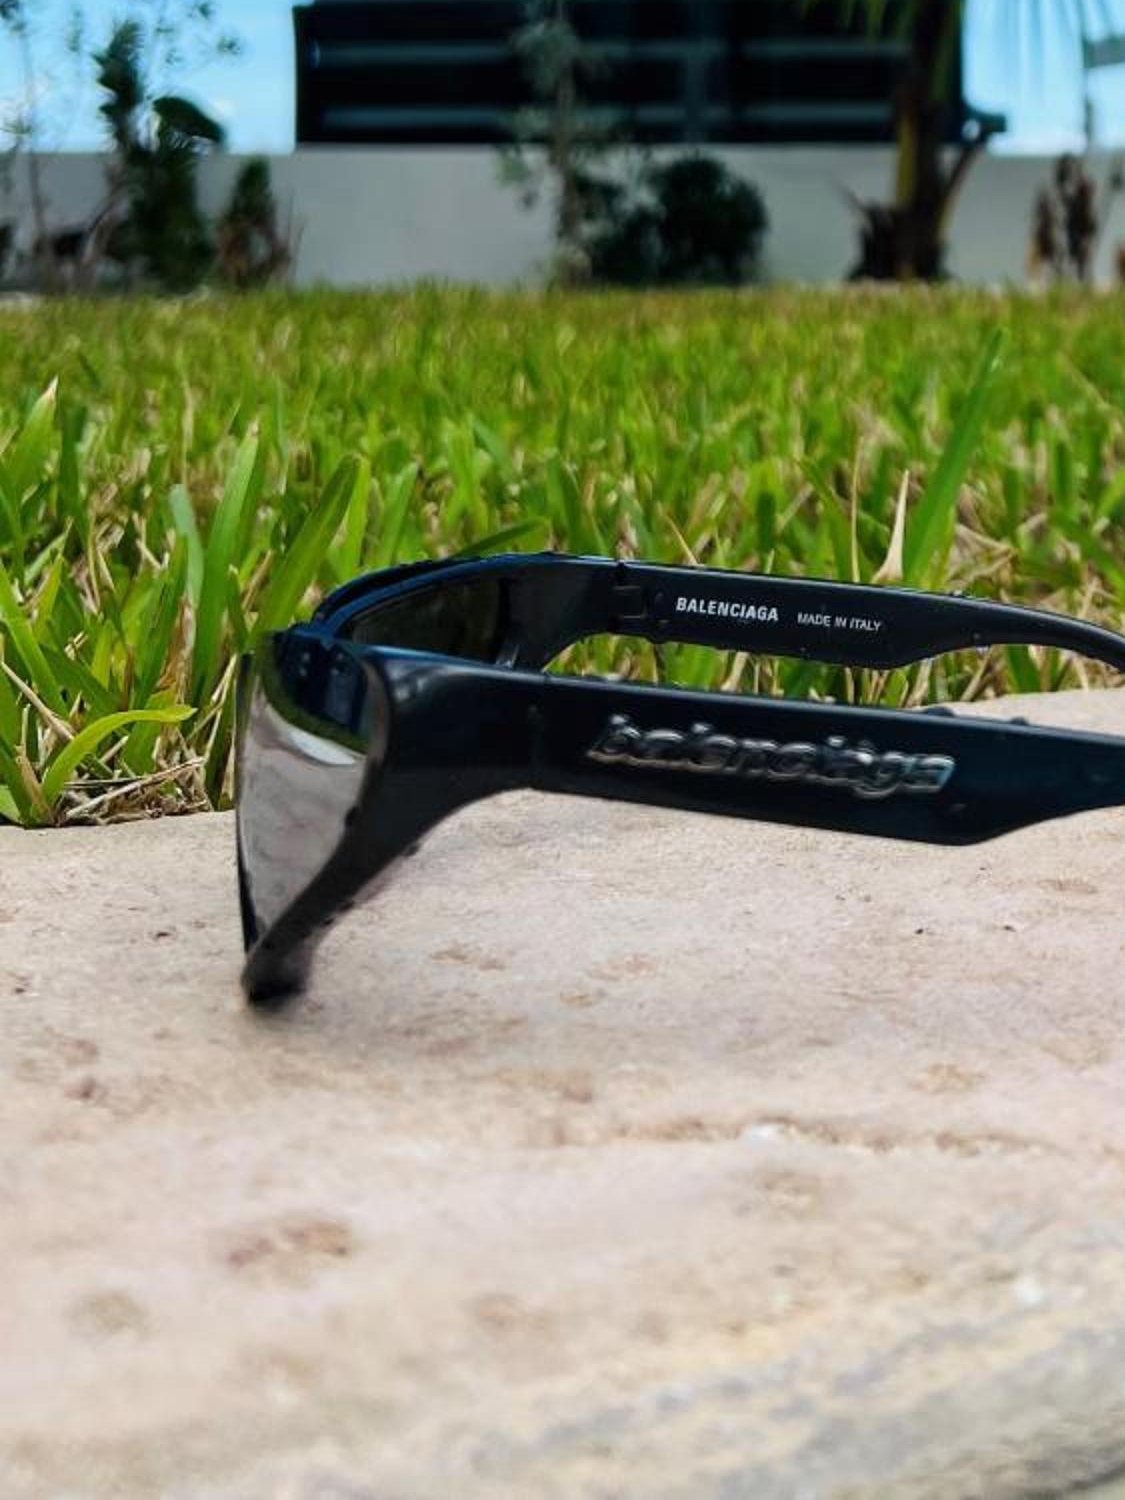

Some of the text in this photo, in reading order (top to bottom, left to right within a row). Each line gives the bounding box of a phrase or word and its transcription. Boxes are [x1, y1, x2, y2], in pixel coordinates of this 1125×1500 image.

[675, 596, 882, 632] BALENCIAGA MADE IN ITALY
